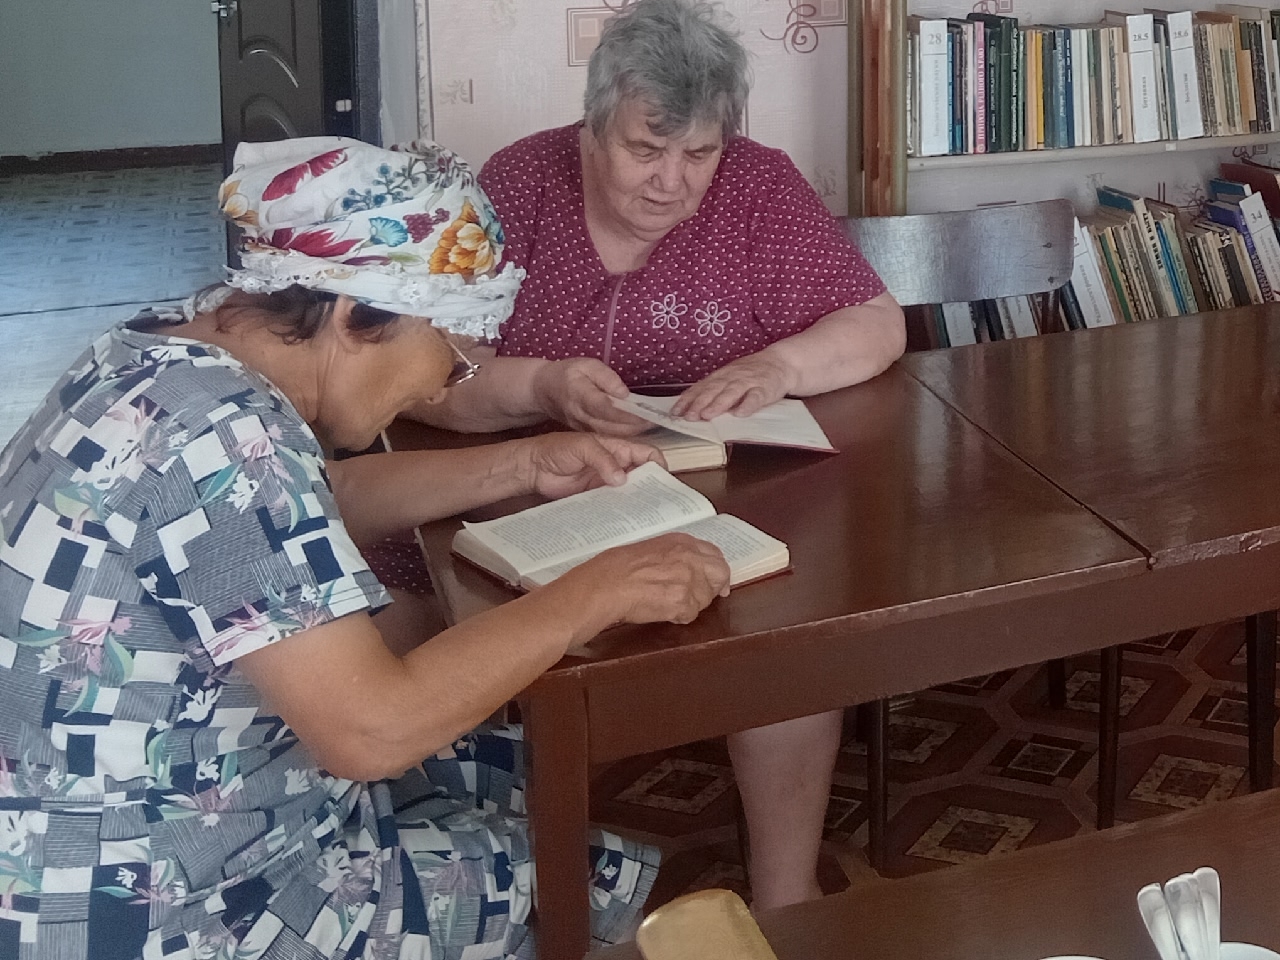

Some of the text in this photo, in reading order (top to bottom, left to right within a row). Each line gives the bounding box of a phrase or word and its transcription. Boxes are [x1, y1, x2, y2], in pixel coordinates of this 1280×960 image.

[928, 33, 942, 45] 28
[1133, 33, 1149, 42] 28.5
[1142, 212, 1153, 233] БЫТУ
[1249, 209, 1263, 224] 34
[1150, 242, 1164, 270] ХИМИЯ
